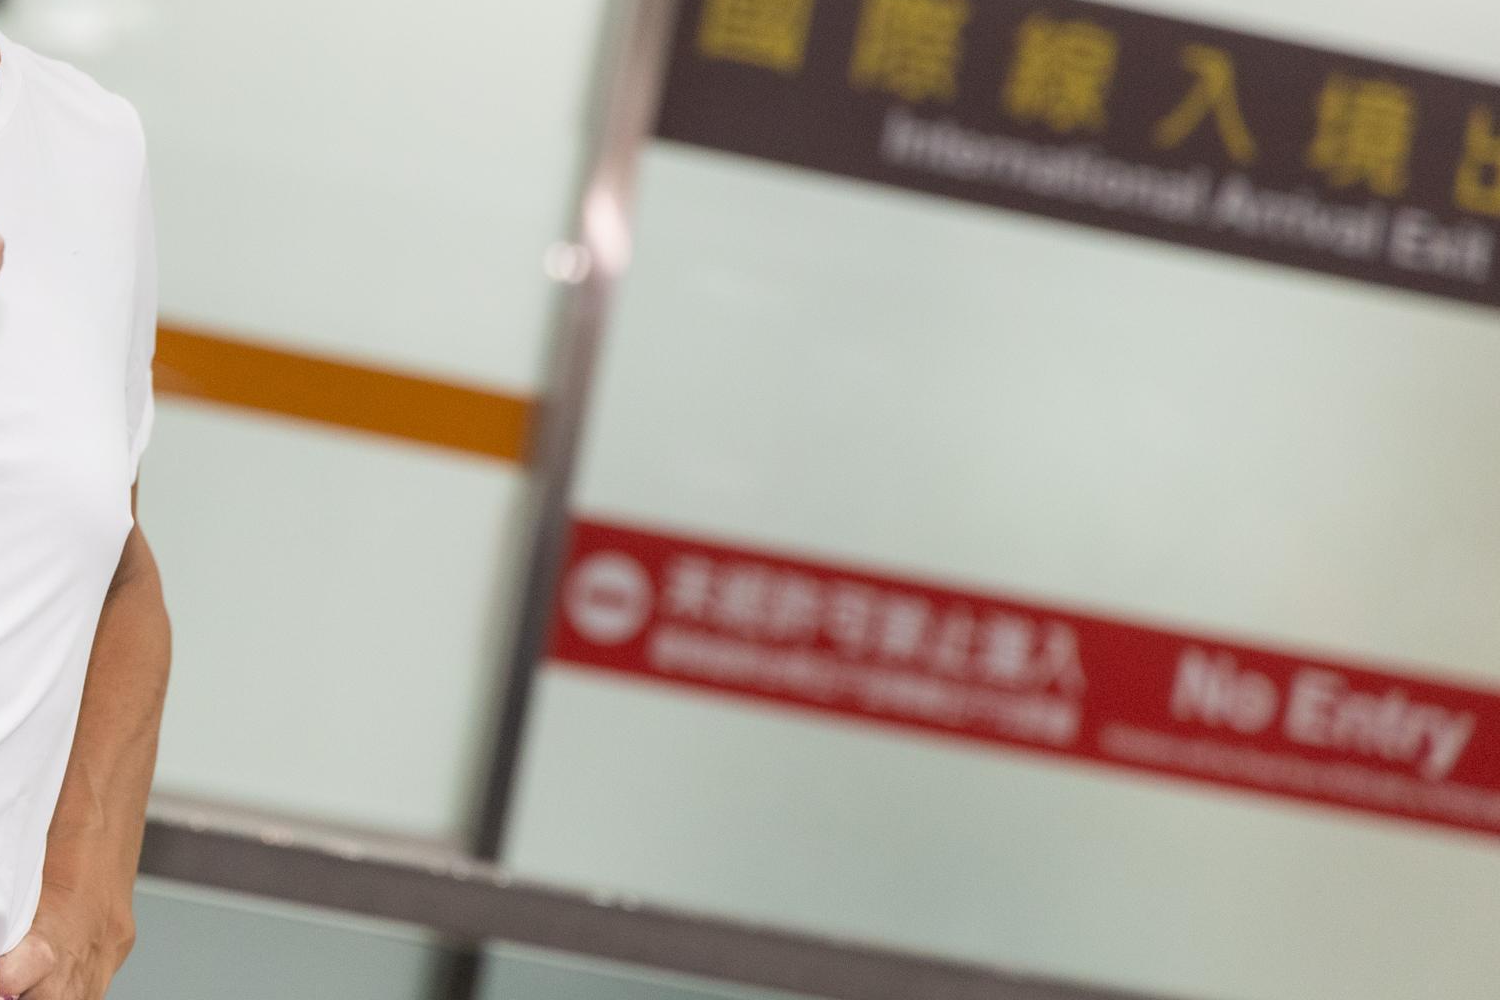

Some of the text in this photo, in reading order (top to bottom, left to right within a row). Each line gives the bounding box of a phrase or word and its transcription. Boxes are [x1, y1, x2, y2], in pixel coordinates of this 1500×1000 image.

[882, 108, 1494, 285] International Arrival Exit
[1169, 646, 1278, 734] No
[1284, 668, 1476, 782] Entry
